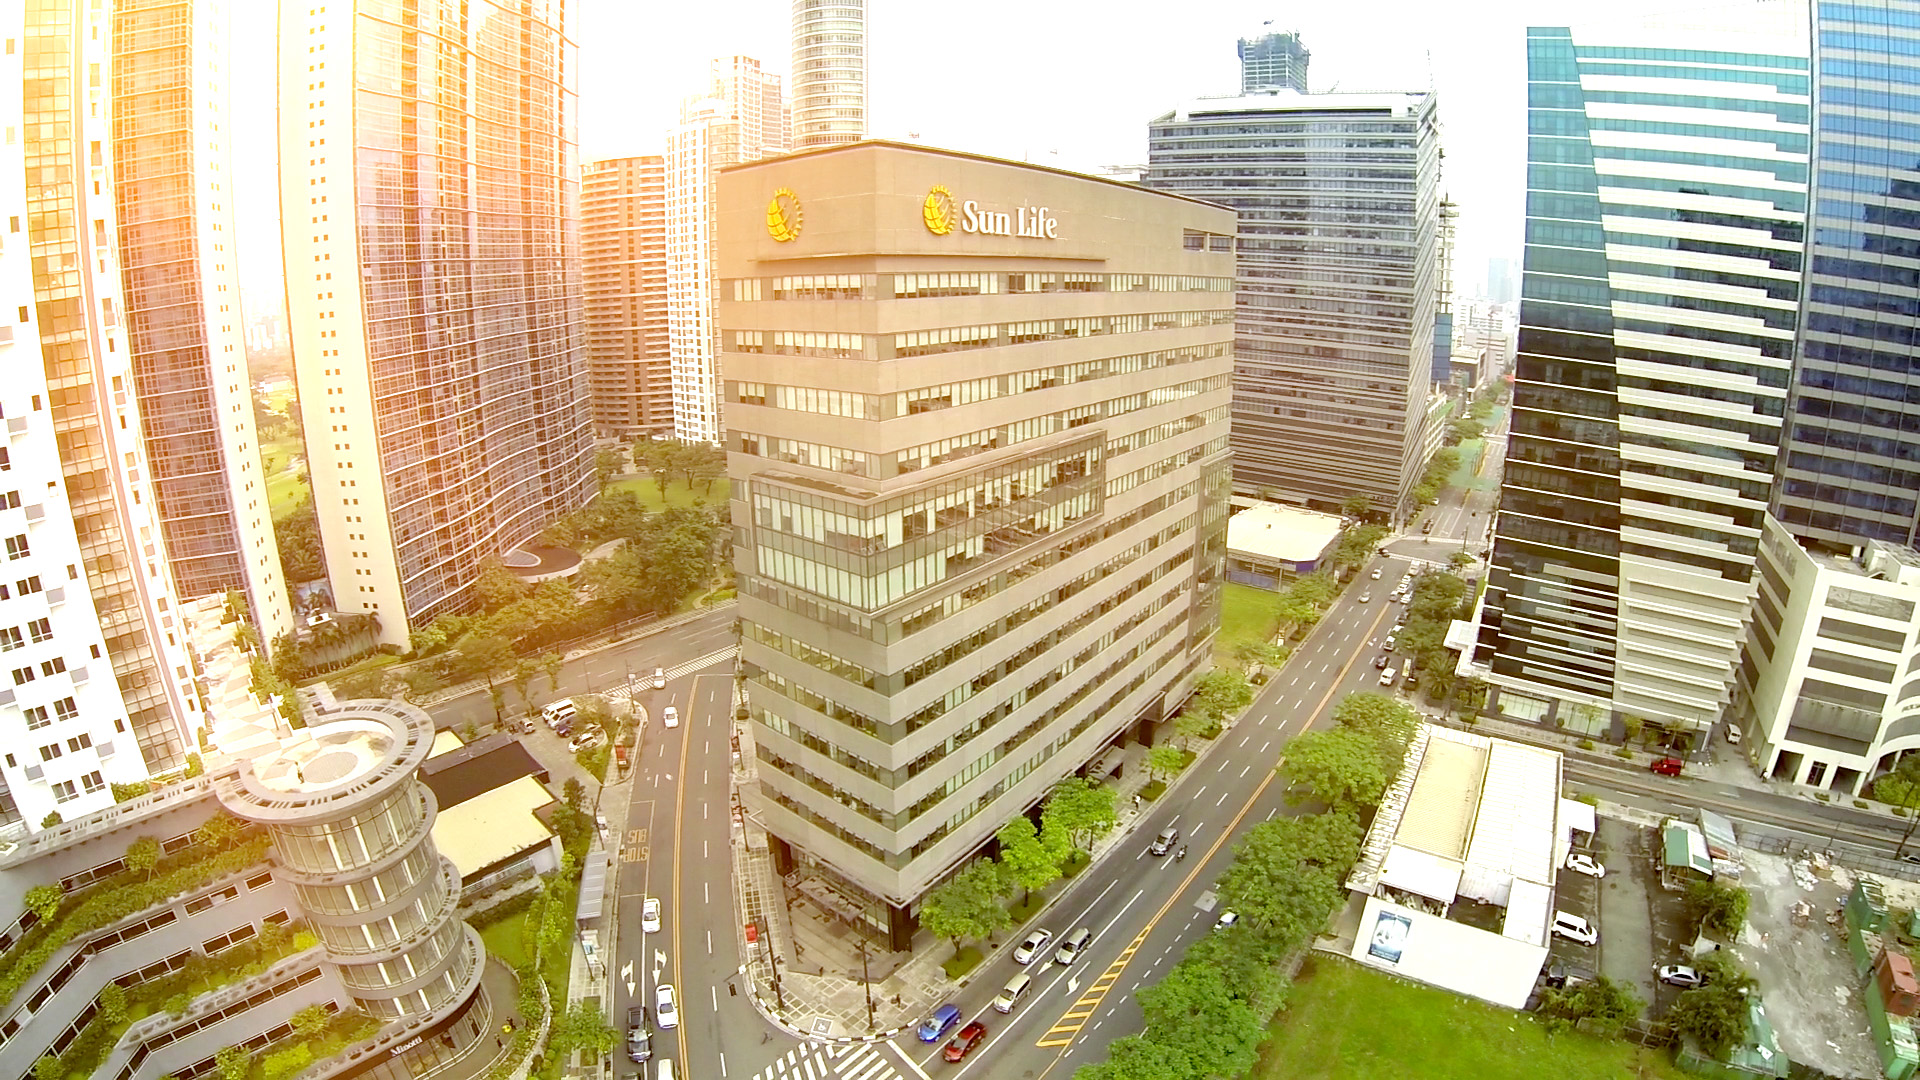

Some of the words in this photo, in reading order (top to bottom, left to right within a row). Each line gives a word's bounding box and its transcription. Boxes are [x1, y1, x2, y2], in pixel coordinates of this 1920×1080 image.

[962, 200, 1011, 236] Sun
[1015, 206, 1058, 239] Life
[627, 829, 647, 844] BUS
[623, 846, 649, 862] STOP
[390, 1036, 423, 1056] Minotti
